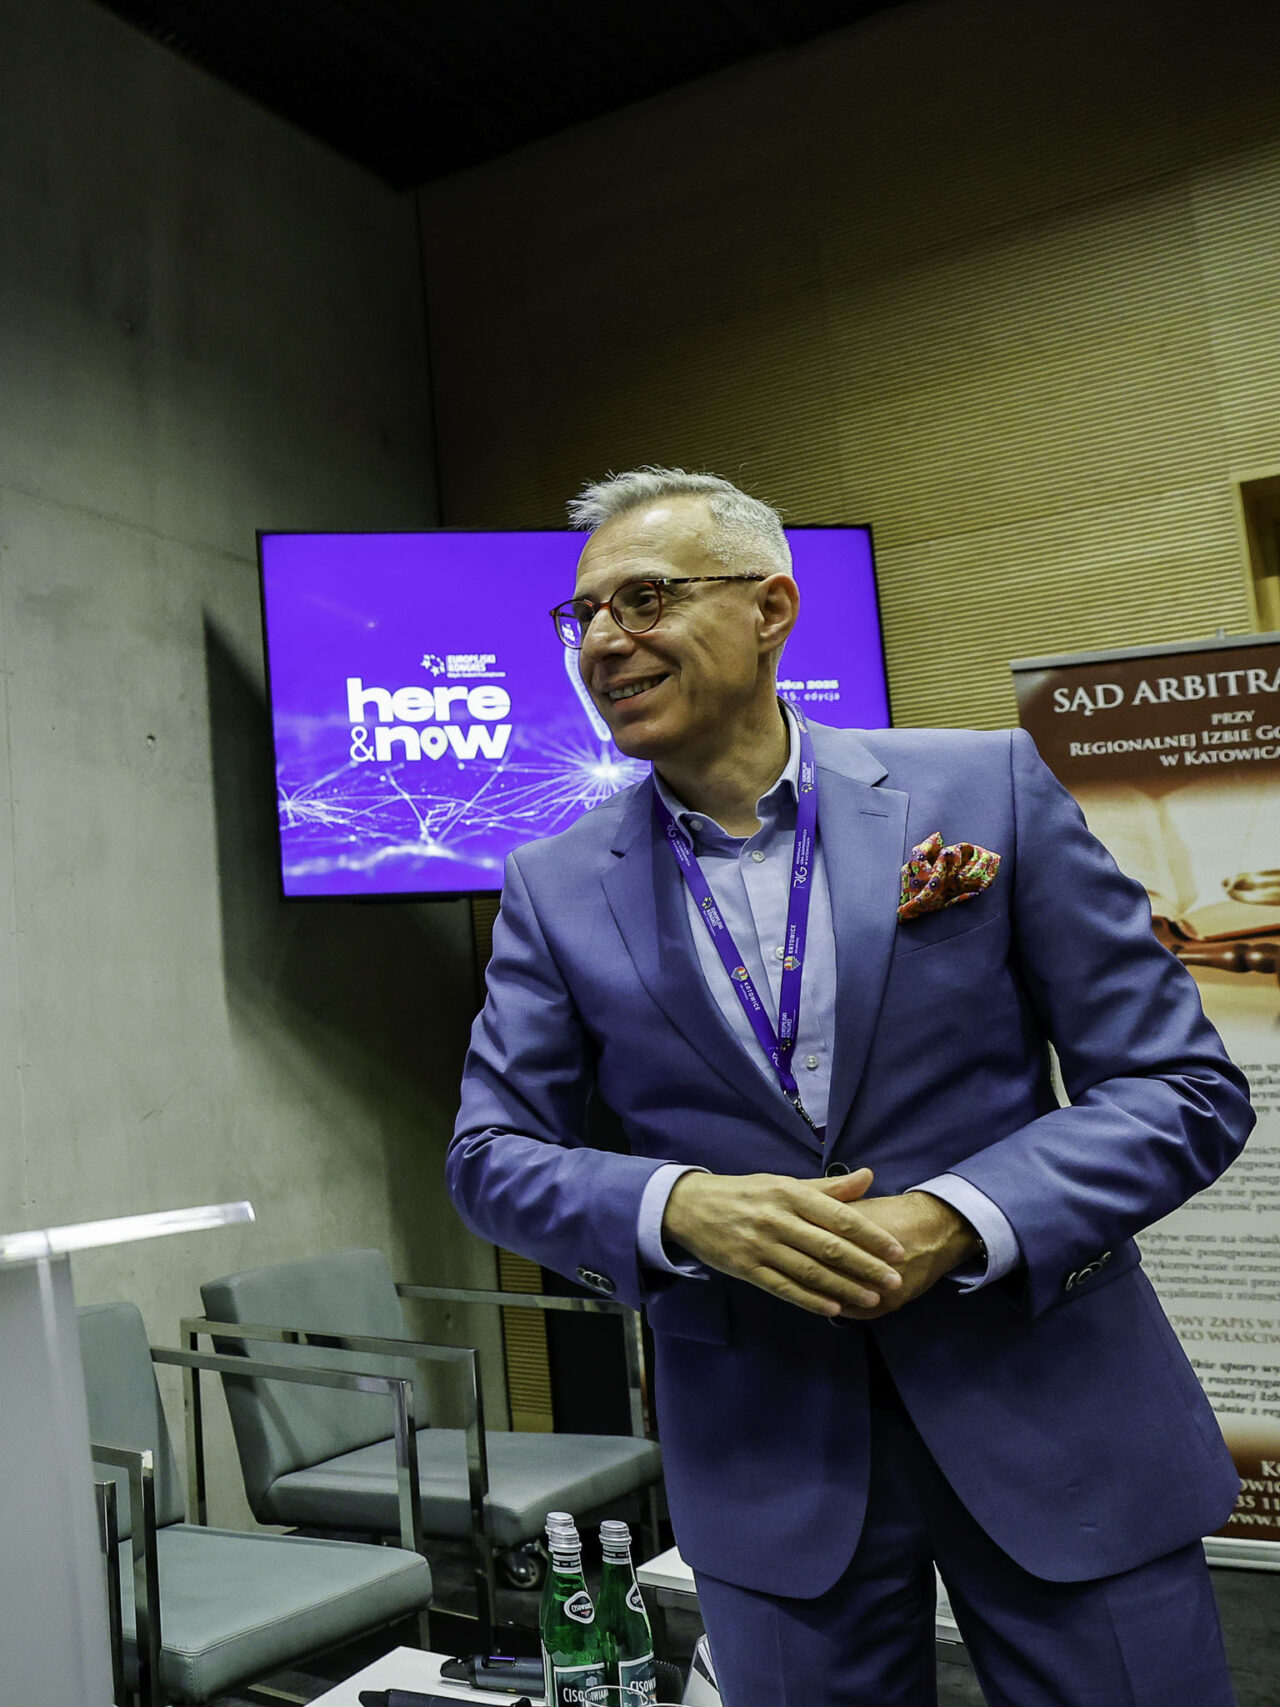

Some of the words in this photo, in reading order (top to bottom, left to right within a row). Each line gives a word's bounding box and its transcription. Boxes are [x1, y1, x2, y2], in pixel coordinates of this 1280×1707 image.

[347, 678, 511, 722] here
[1053, 684, 1124, 716] SĄD
[1184, 746, 1280, 766] KATOWIC
